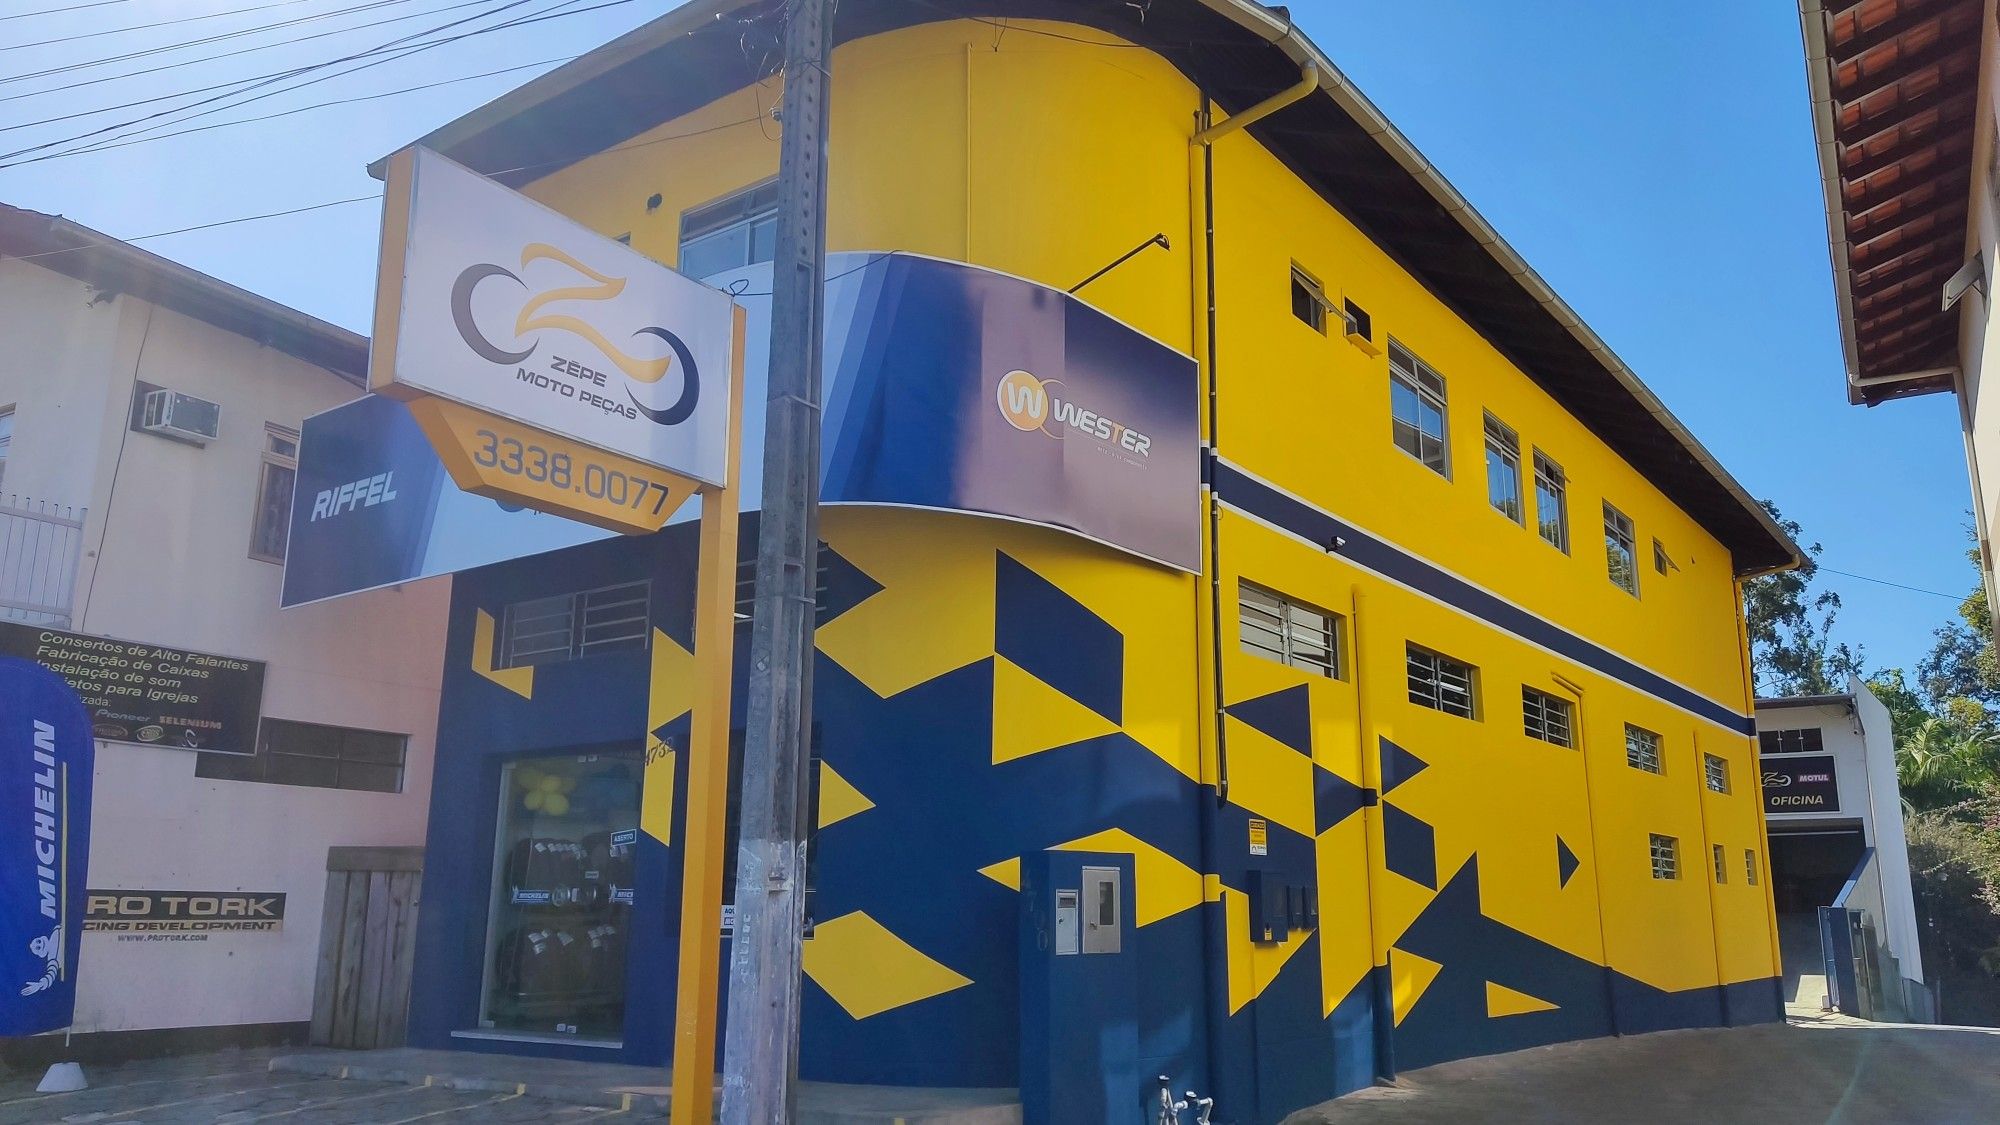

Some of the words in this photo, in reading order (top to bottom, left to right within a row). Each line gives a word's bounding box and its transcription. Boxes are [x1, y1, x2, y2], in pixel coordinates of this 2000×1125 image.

[516, 368, 575, 398] MOTO
[579, 390, 638, 420] PEÇAS
[1053, 398, 1151, 457] WESTER
[474, 429, 669, 515] 3338.0077
[311, 471, 397, 522] RIFFEL
[36, 645, 128, 667] Fabricação
[133, 660, 152, 671] de
[158, 663, 210, 678] Caixas
[40, 631, 123, 653] Consertos
[128, 646, 148, 657] de
[150, 649, 181, 662] Alto
[185, 654, 249, 671] Falantes
[105, 685, 142, 697] para
[147, 688, 199, 703] Igrejas
[124, 672, 144, 683] de
[148, 677, 181, 688] som
[1799, 774, 1829, 782] MOTUL
[1771, 795, 1824, 806] OFICINA
[33, 719, 56, 919] MICHELIN
[86, 895, 151, 915] RO
[160, 897, 277, 916] TORK
[83, 921, 131, 931] CING
[134, 921, 277, 931] DEVELOPMENT
